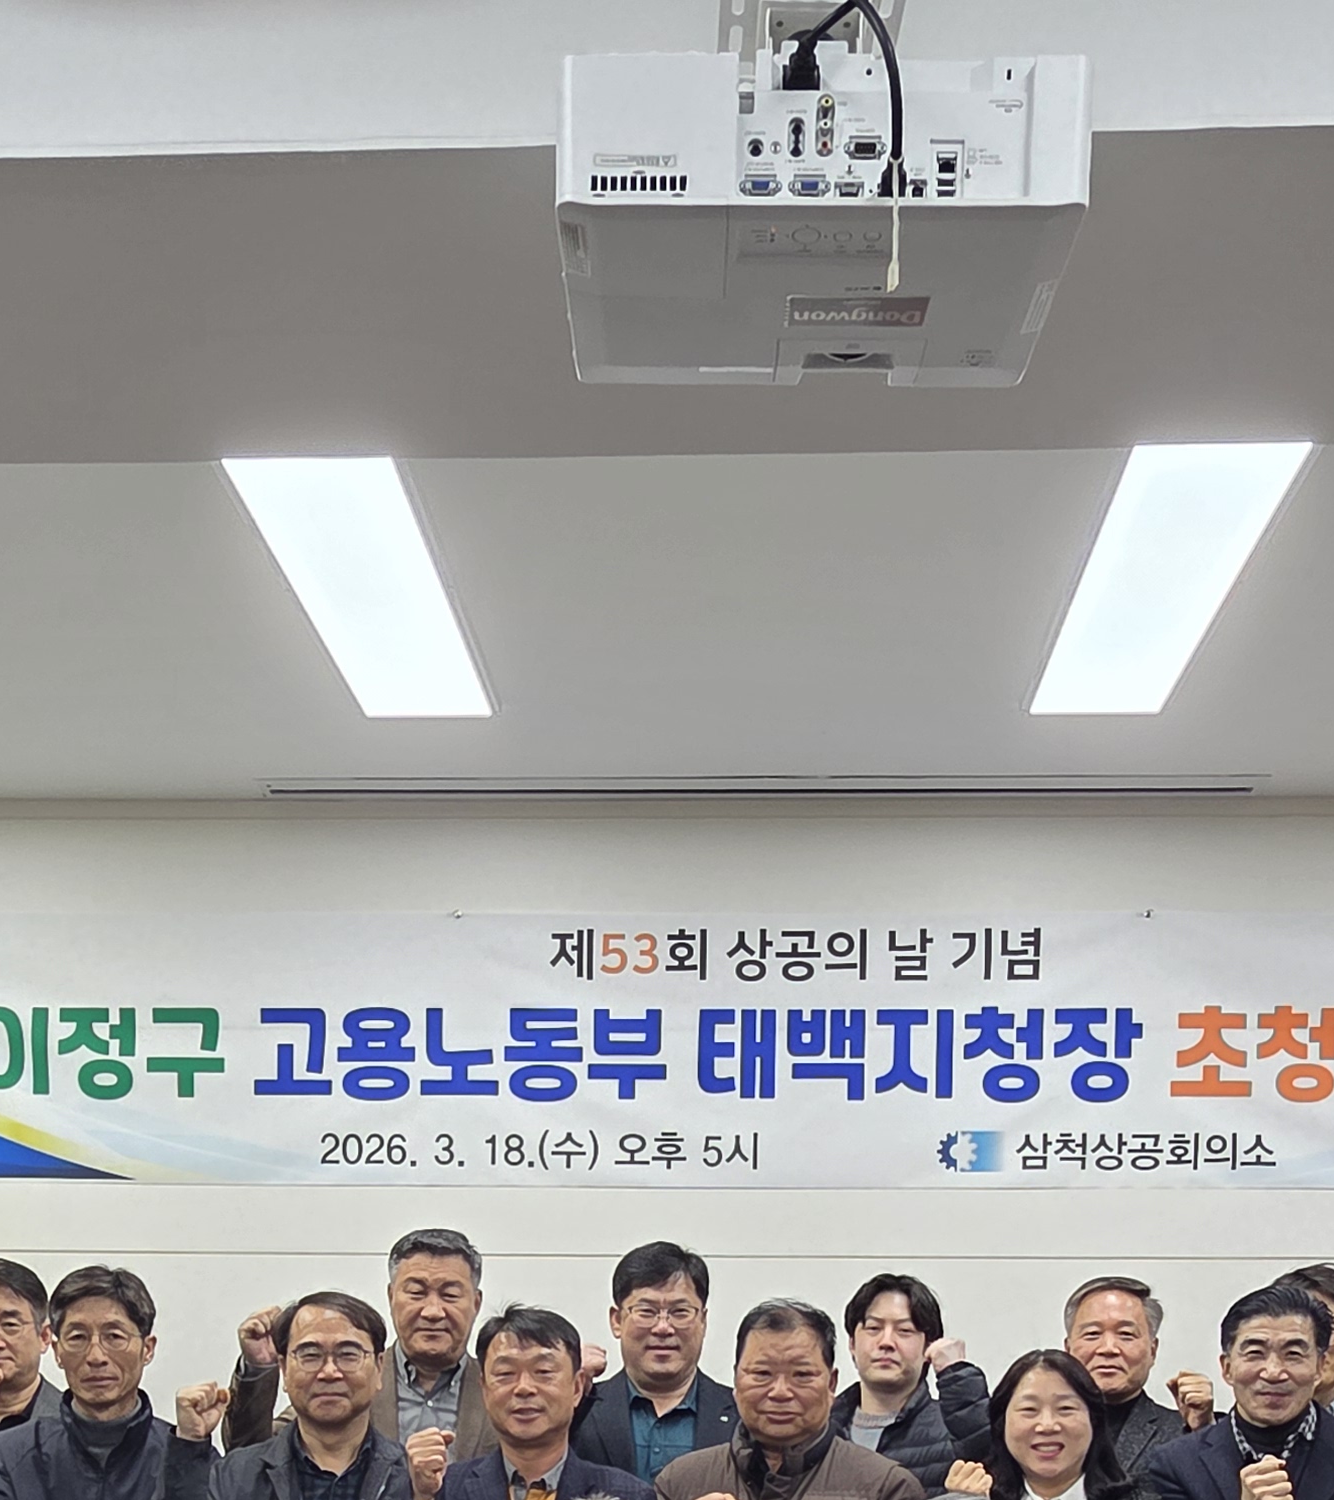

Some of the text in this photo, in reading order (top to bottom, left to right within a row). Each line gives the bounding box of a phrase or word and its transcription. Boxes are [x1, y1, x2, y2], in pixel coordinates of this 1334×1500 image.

[793, 307, 922, 324] Dongwon
[549, 927, 1042, 982] 제53회 상공의 날 기념
[253, 1006, 668, 1103] 고용노동부
[696, 1005, 1144, 1104] 태백지청장
[320, 1129, 760, 1171] 2026. 3. 18.(수) 오후 5시
[1015, 1132, 1277, 1172] 삼척상공회의소
